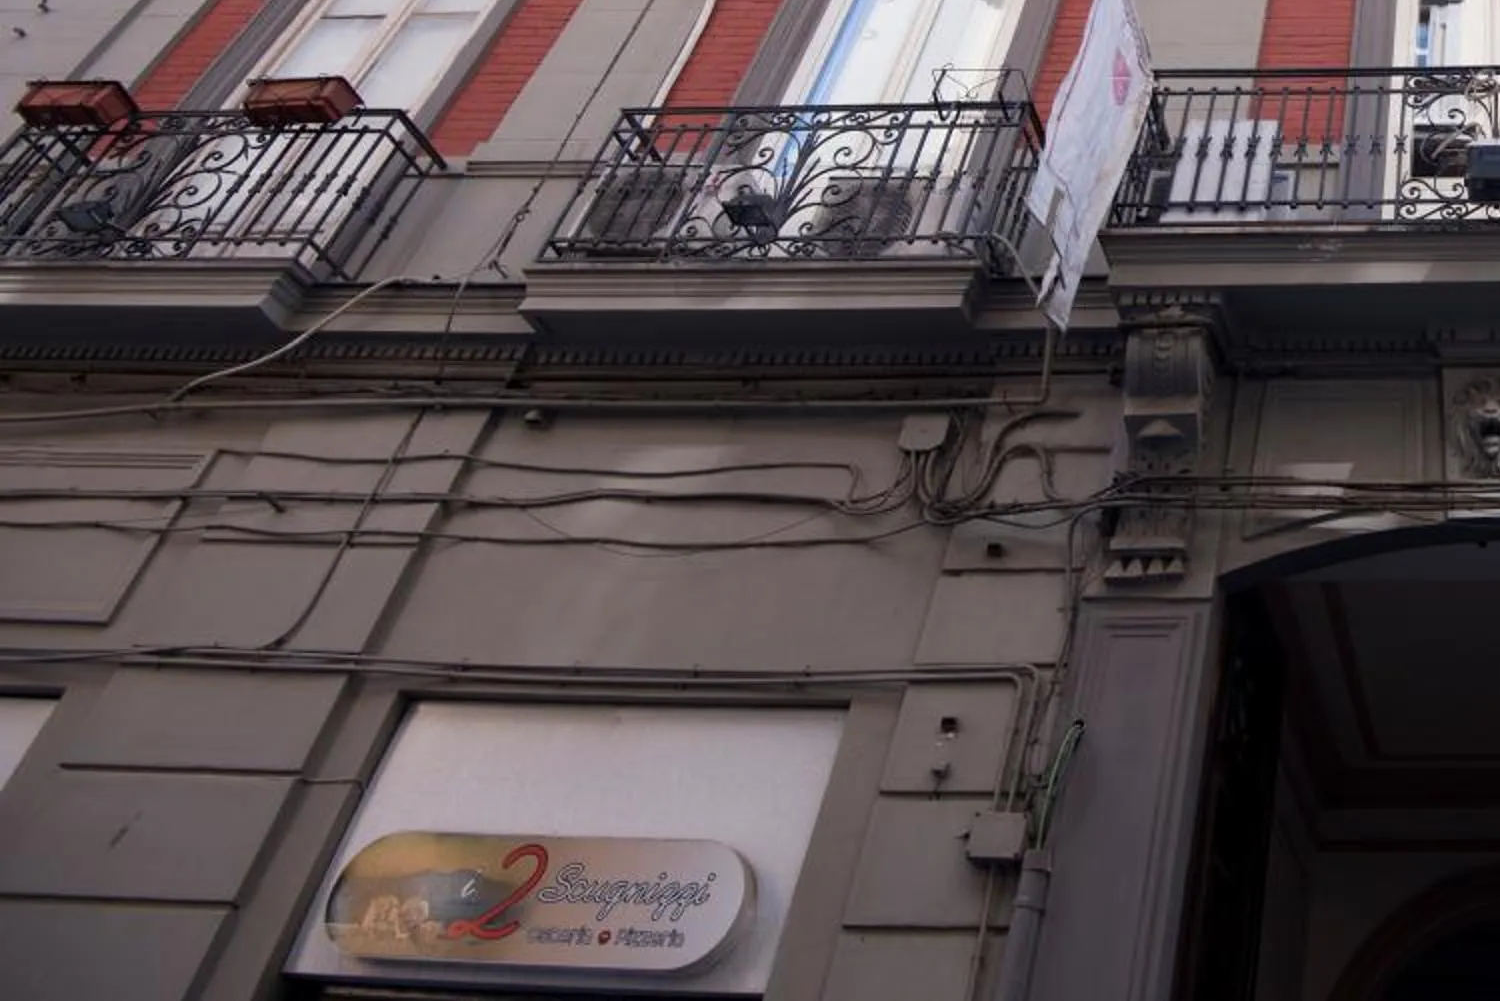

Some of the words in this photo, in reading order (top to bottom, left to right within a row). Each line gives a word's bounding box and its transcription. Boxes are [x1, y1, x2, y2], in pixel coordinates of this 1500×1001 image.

[447, 843, 549, 939] 2
[537, 862, 717, 922] Scugnizzi
[615, 926, 686, 948] Pizzeria
